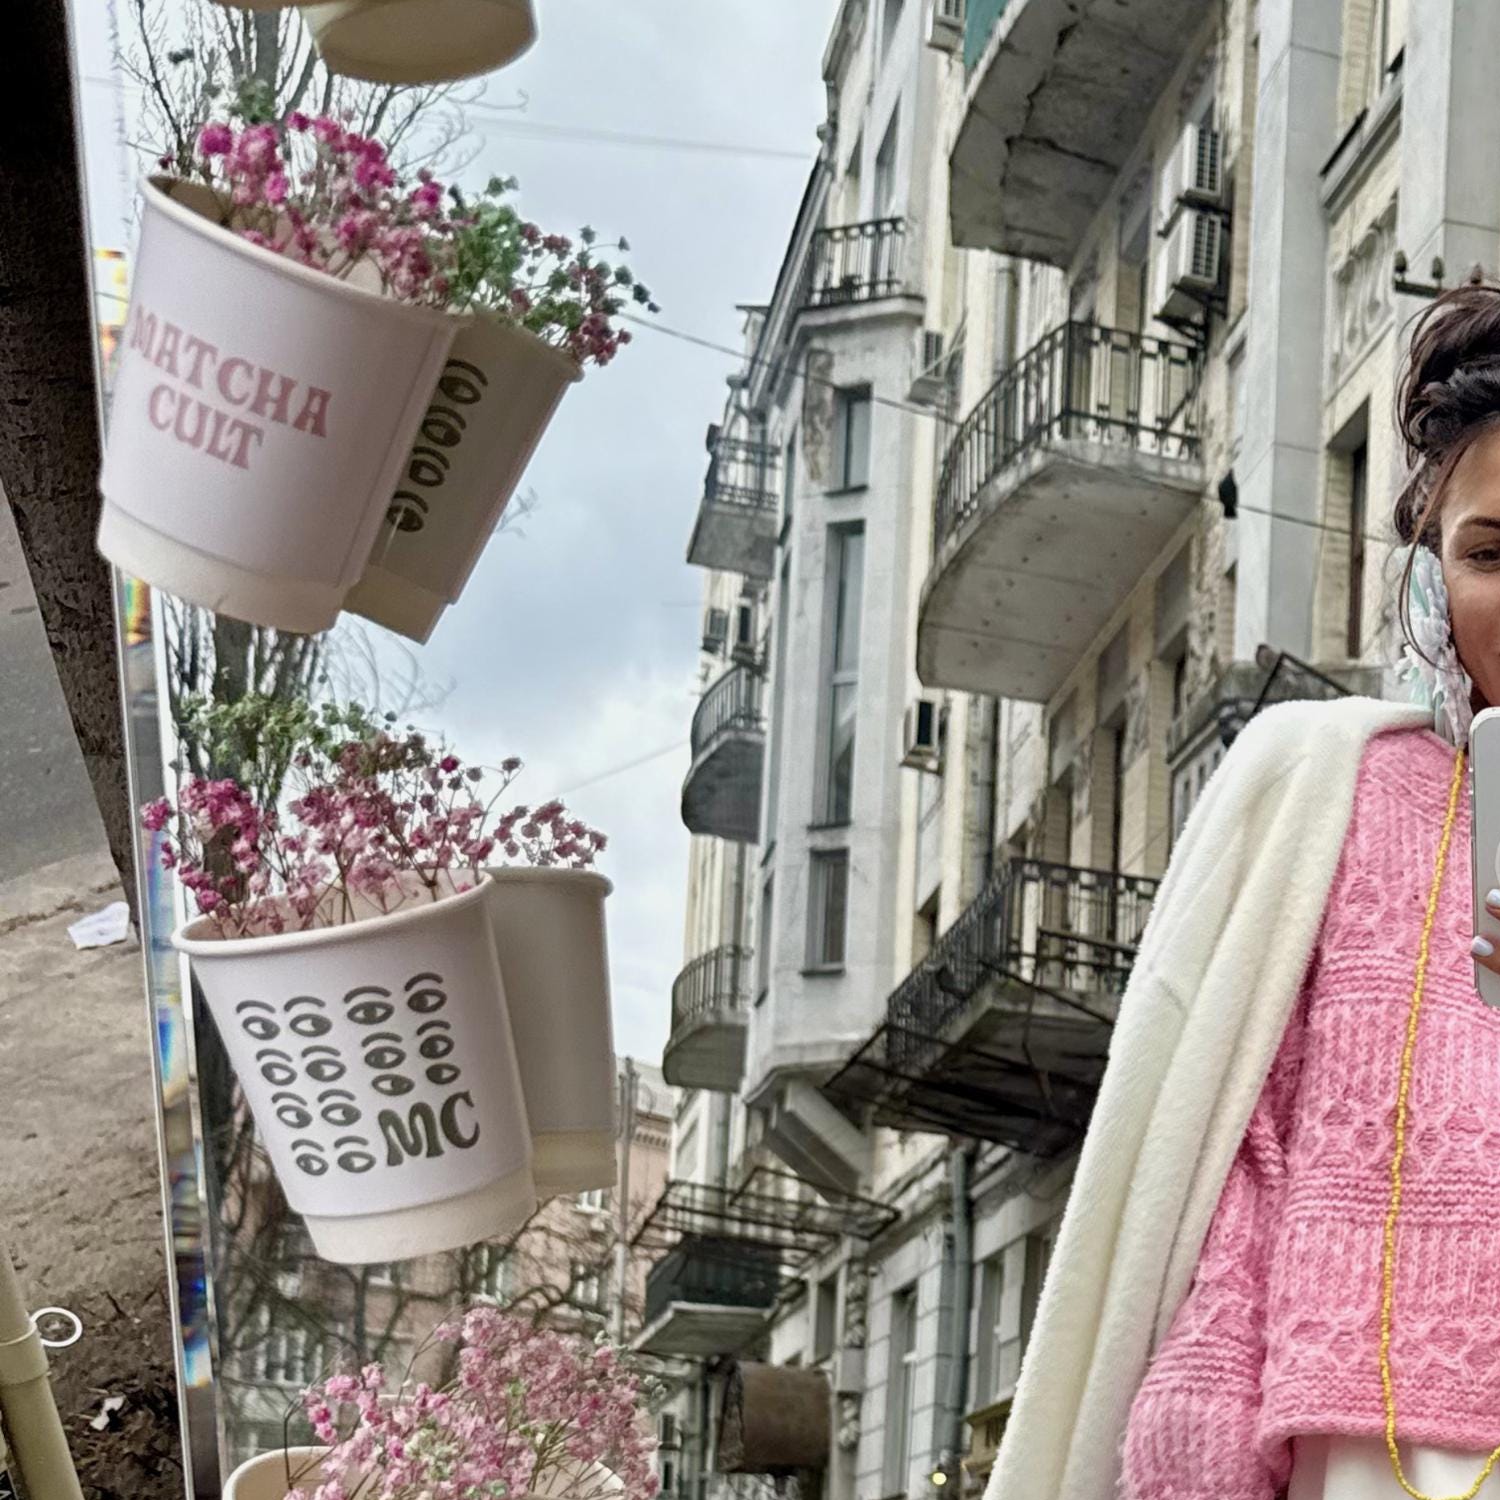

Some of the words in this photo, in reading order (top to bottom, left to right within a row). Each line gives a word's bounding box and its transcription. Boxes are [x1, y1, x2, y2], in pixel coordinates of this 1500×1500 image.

[130, 304, 332, 438] MATCHA
[147, 384, 265, 471] CULT
[377, 1091, 481, 1168] MC
